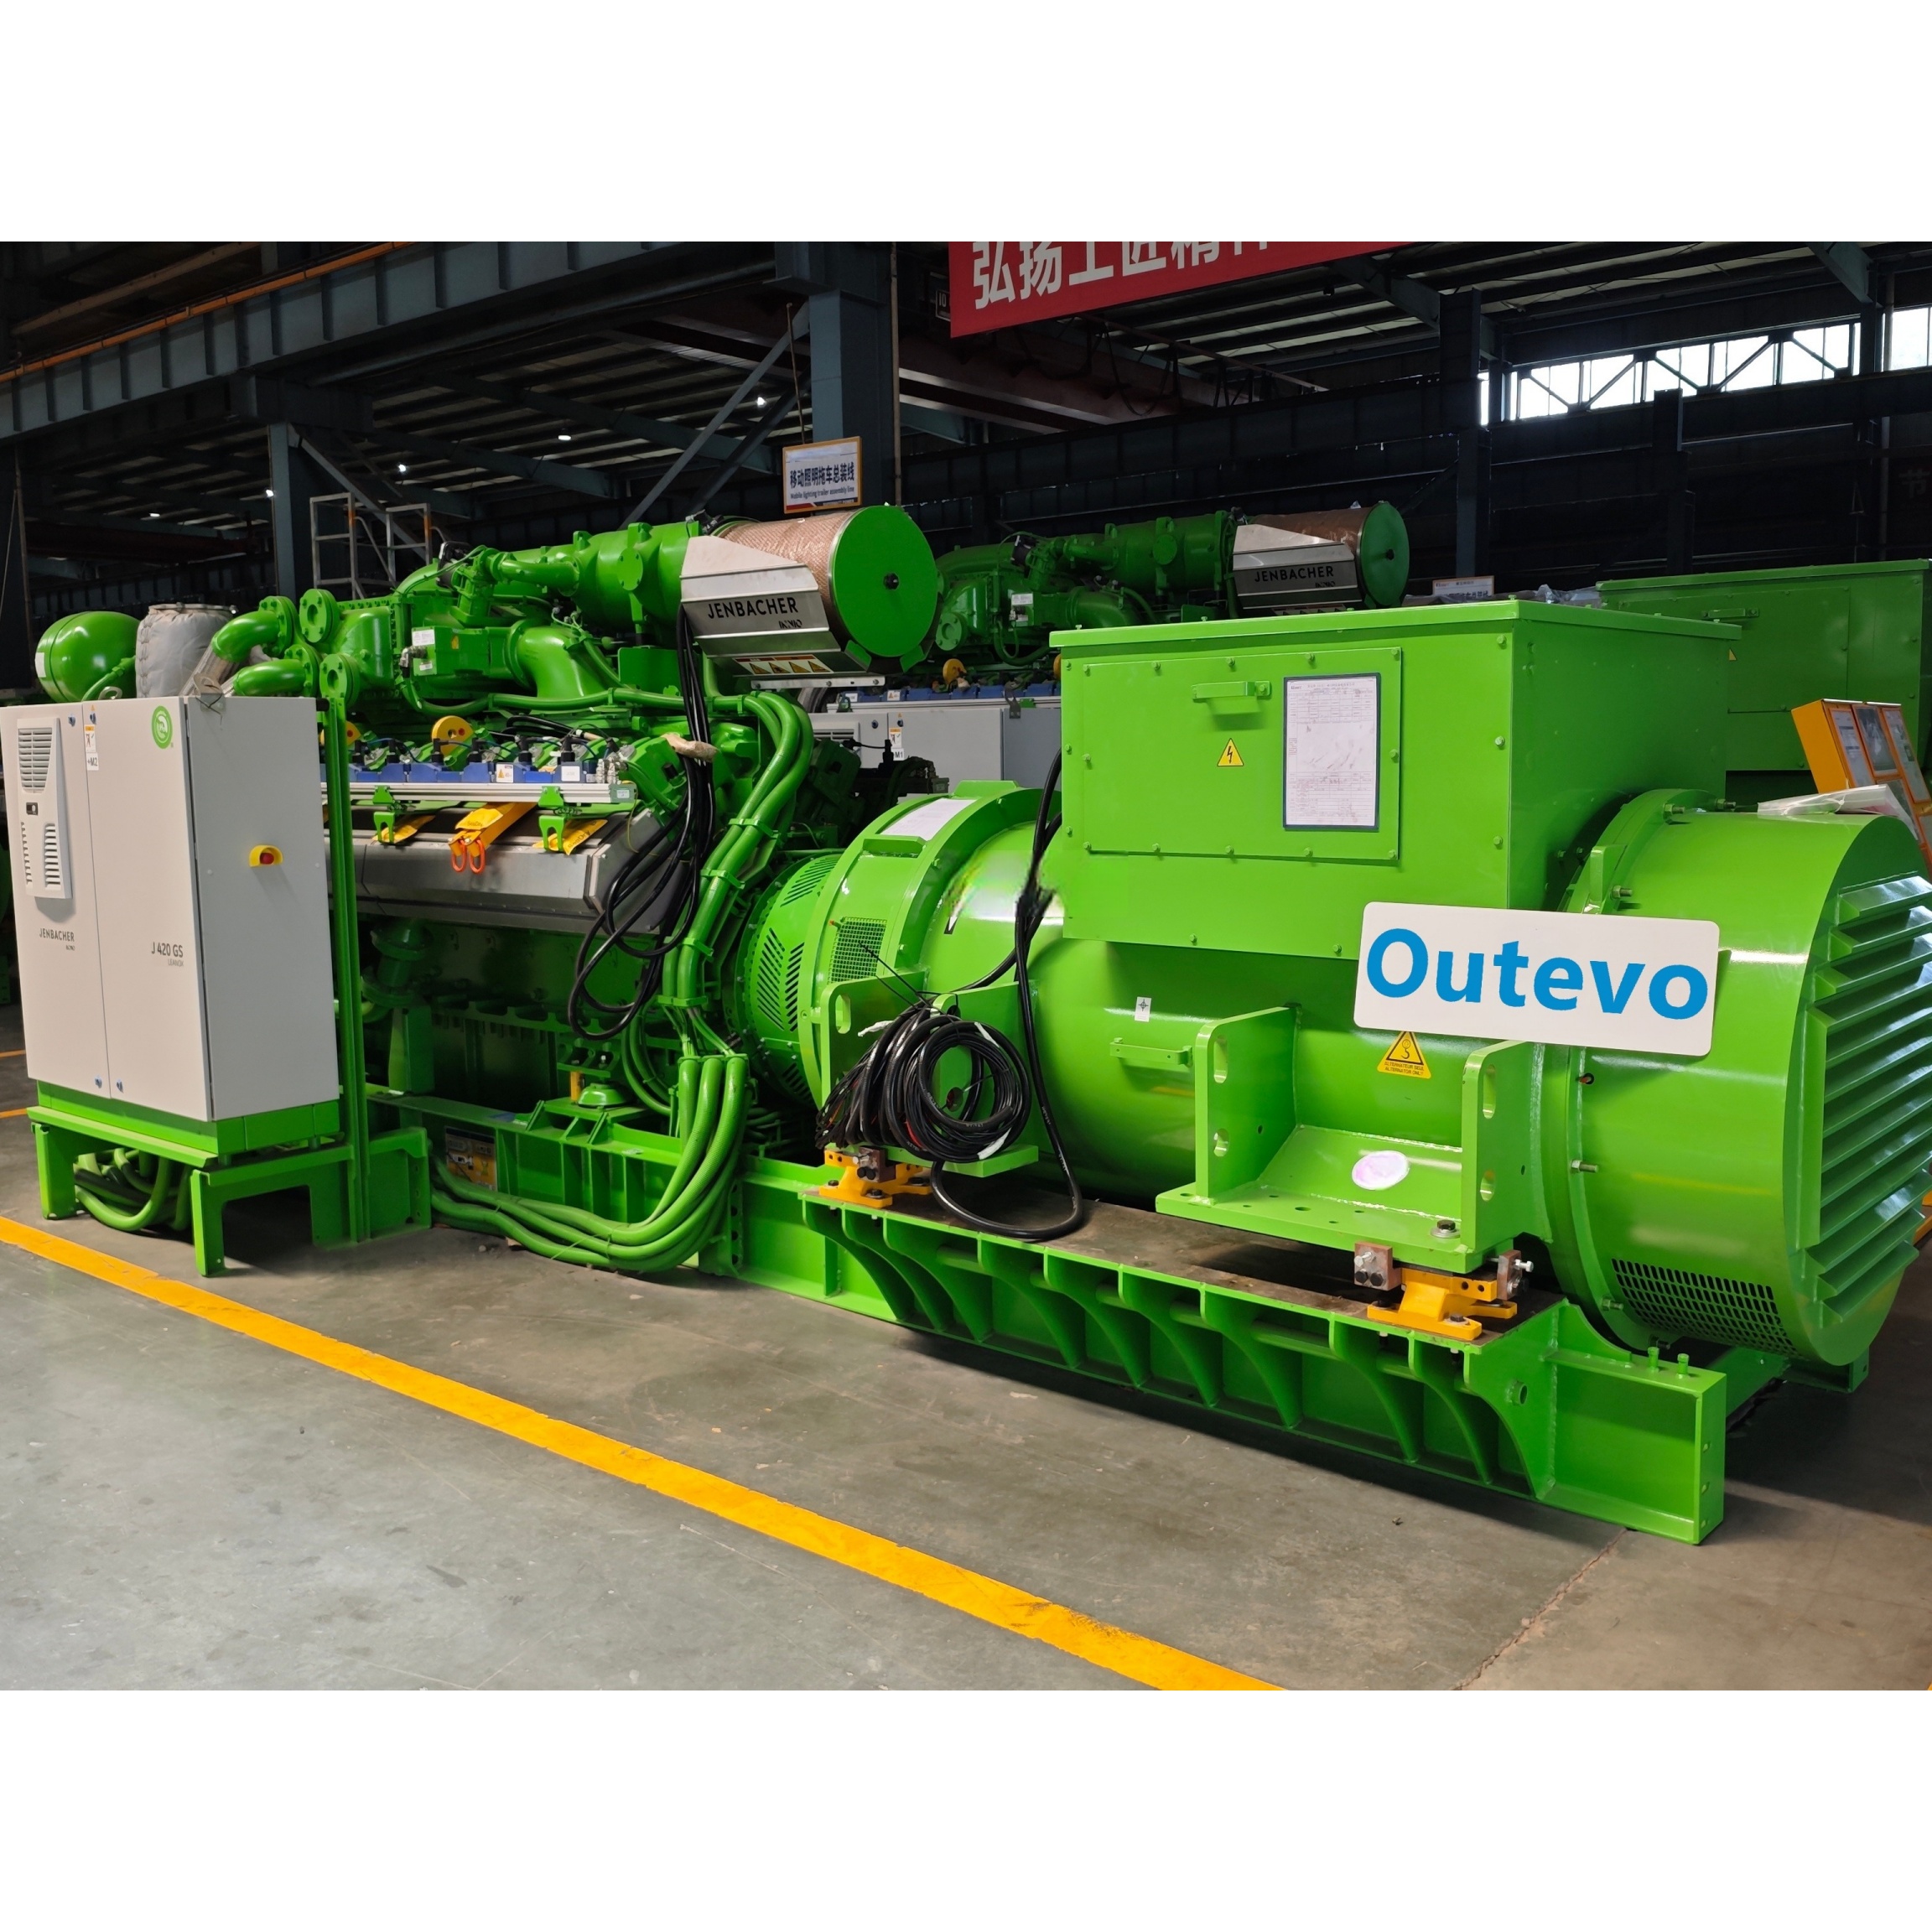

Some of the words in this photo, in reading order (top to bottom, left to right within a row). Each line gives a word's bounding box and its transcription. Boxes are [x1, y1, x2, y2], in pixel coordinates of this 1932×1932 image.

[973, 242, 1268, 310] 弘扬工匠
[803, 490, 817, 500] lighting
[830, 486, 847, 495] assembly
[1254, 565, 1334, 582] JENBACHER
[708, 597, 798, 619] JENBACHER
[39, 927, 75, 942] JENBACHER
[151, 942, 155, 954] J
[157, 943, 171, 957] 420
[173, 944, 184, 958] GS
[1366, 927, 1708, 1020] Outevo
